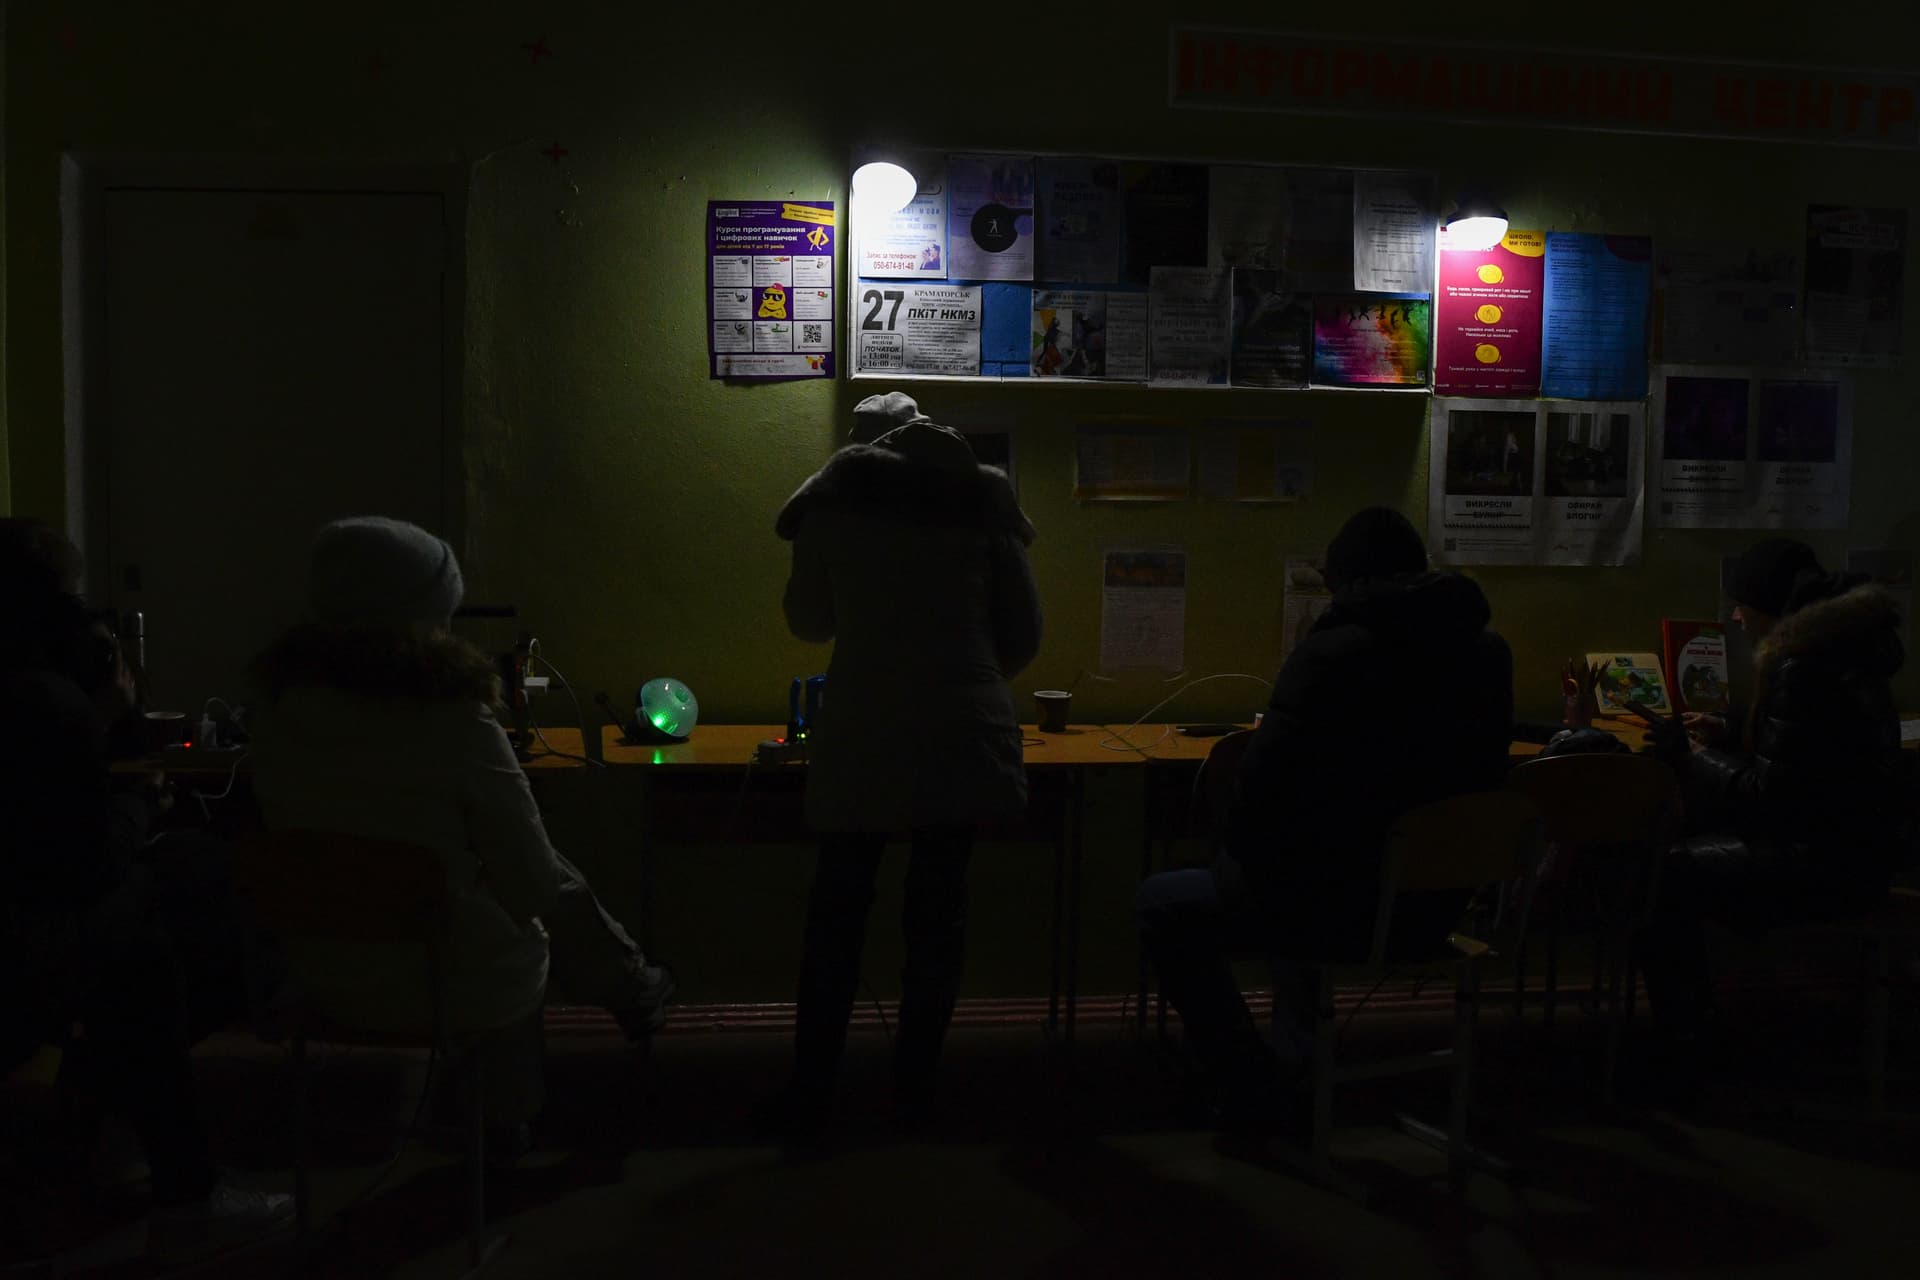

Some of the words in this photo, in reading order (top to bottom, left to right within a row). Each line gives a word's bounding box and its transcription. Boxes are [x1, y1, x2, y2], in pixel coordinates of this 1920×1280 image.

[1714, 78, 1914, 138] ЦЕНТР
[715, 226, 742, 235] Курси
[742, 227, 806, 235] програмування
[720, 235, 762, 243] цифрових
[914, 290, 970, 298] КРАМАТОРСЬК
[862, 289, 905, 331] 27
[908, 308, 938, 319] ПКіТ
[941, 309, 976, 320] НКМЗ
[864, 345, 900, 353] ПОЧАТОК
